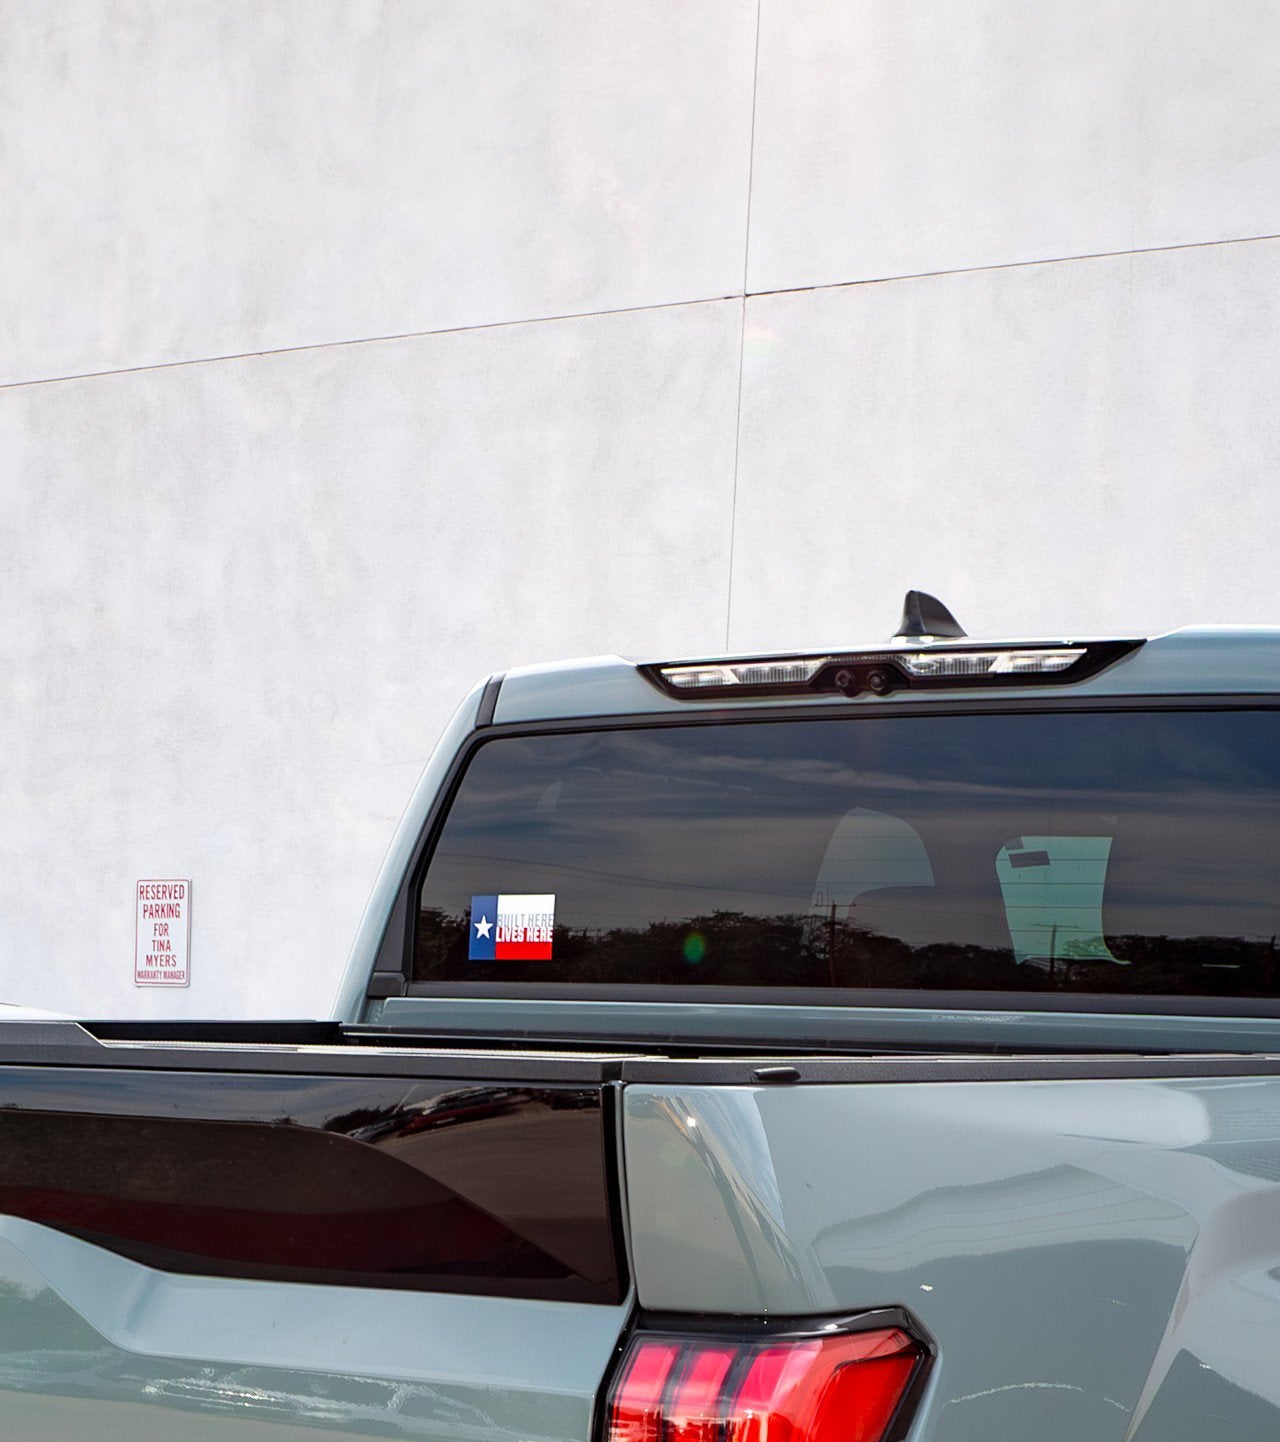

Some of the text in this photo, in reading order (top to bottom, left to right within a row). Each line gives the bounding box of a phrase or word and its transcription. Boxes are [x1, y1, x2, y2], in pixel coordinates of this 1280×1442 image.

[140, 885, 185, 900] RESERVED
[143, 903, 180, 919] PARKING
[497, 913, 555, 928] BUILT HERE
[153, 923, 169, 936] FOR
[495, 927, 553, 943] LIVES HERE
[152, 940, 171, 952] TINA
[146, 955, 177, 967] MYERS
[137, 970, 185, 980] WARRANTY MANAGER
